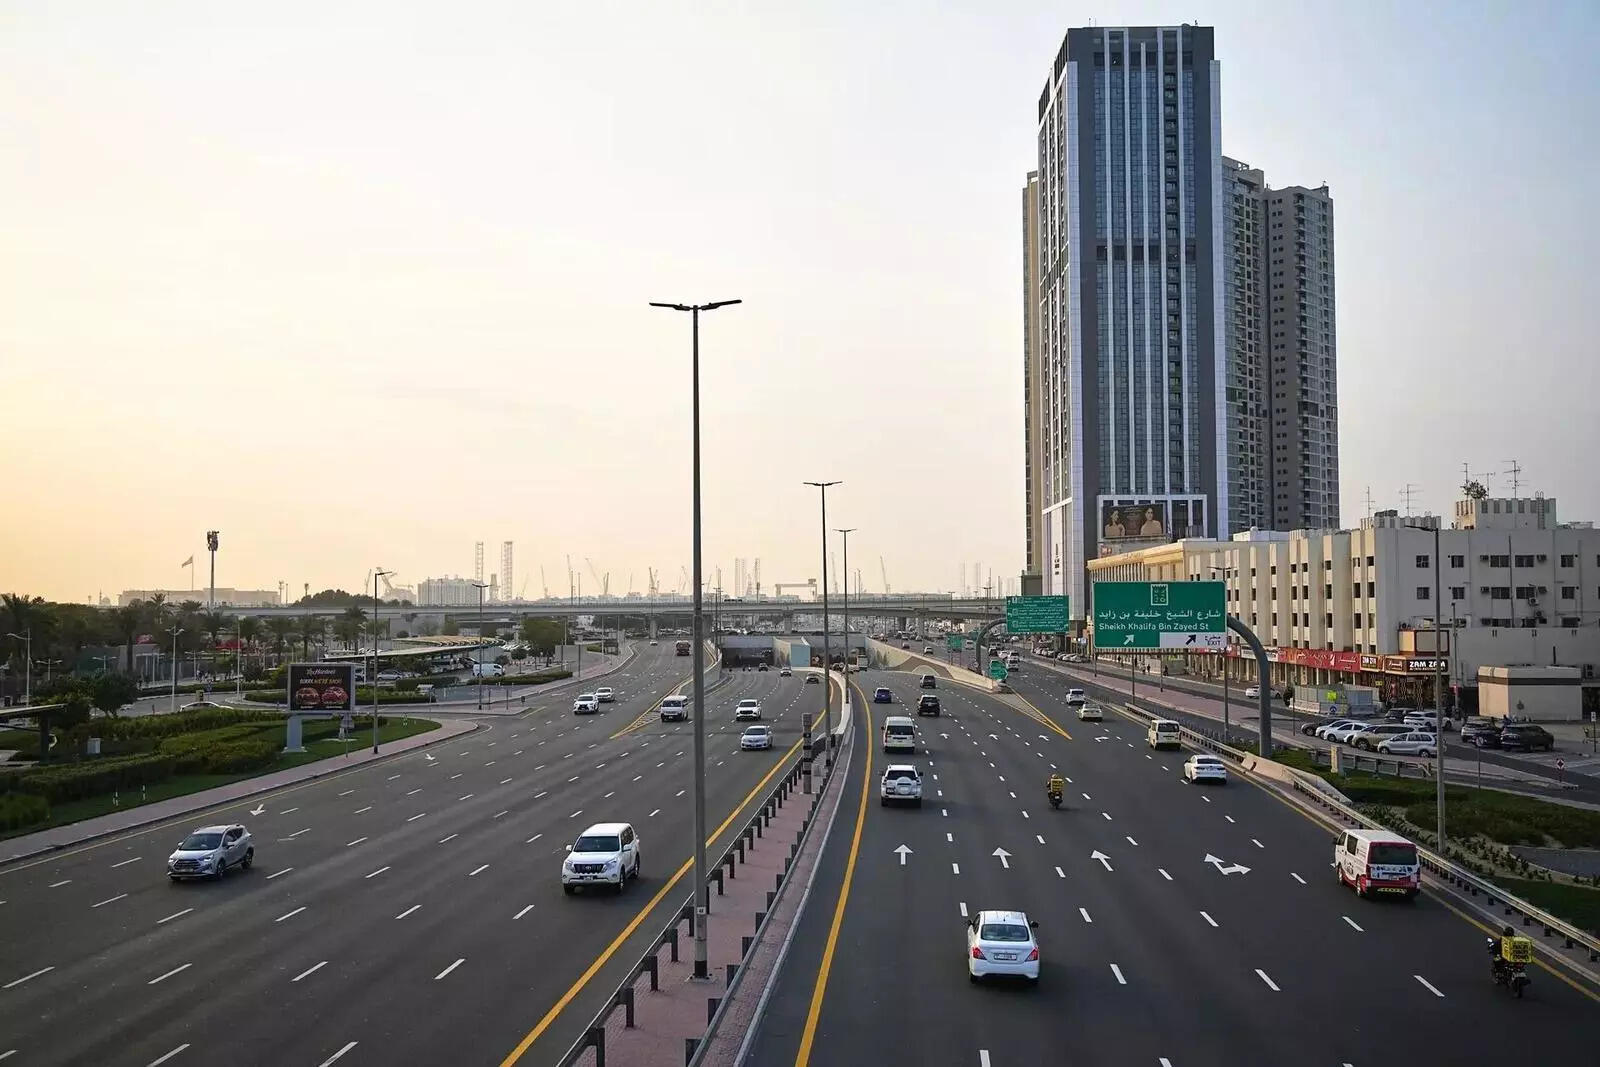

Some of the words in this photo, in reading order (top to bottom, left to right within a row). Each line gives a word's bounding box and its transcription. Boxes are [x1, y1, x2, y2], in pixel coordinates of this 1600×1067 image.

[1099, 609, 1116, 620] زايد
[1119, 611, 1130, 620] بن
[1134, 609, 1162, 620] خليفة
[1166, 609, 1193, 620] الشيخ
[1197, 609, 1221, 620] شارع
[1099, 622, 1126, 630] Sheikh
[1128, 622, 1156, 630] Khalifa
[1158, 622, 1172, 630] Bin
[1173, 622, 1198, 631] Zayed
[1199, 622, 1209, 630] St
[1409, 660, 1427, 668] ZAM
